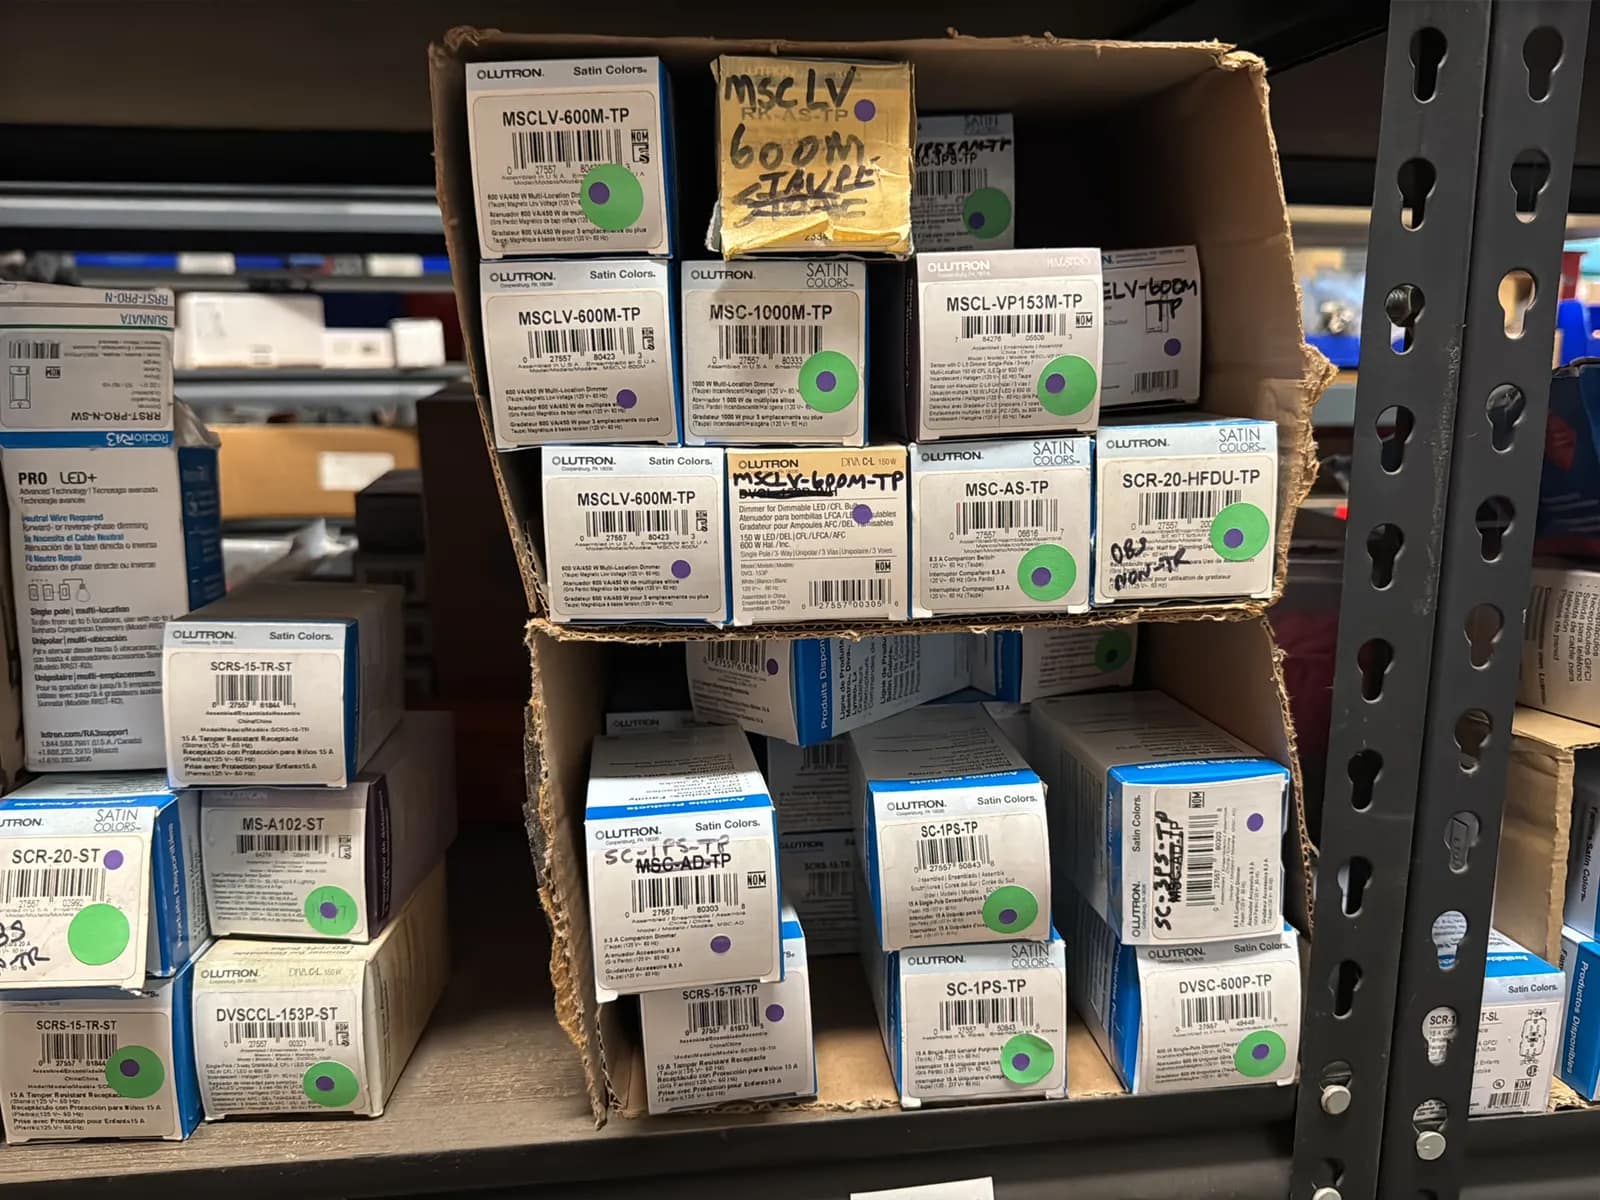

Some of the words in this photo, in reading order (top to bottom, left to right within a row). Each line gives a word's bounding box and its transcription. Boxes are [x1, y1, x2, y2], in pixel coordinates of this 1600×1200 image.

[573, 66, 602, 76] Satin
[503, 108, 629, 126] MSCLV-600M-TP
[632, 131, 648, 142] NOM
[590, 271, 616, 279] Satin
[807, 263, 848, 277] SATIN
[807, 278, 848, 288] COLORS
[105, 292, 168, 305] RRST-PRO-N
[947, 294, 1082, 312] MSCL-VP153M-TP
[519, 307, 641, 326] MSCLV-600M-TP
[710, 304, 832, 320] MSC-1000M-TP
[120, 313, 168, 325] SUNNATA
[1076, 315, 1092, 326] NOM
[550, 355, 571, 363] 27557
[594, 353, 615, 361] 80423
[71, 412, 161, 421] RRST-PRO-N-SW
[1219, 428, 1260, 442] SATIN
[1034, 441, 1074, 456] SATIN
[1219, 442, 1260, 452] COLORS
[649, 457, 674, 466] Satin
[1033, 455, 1074, 465] COLORS
[19, 472, 47, 485] PRO
[1123, 469, 1260, 488] SCR-20-HFDU-TP
[966, 481, 1049, 497] MSC-AS-TP
[578, 491, 695, 506] MSCLV-600M-TP
[791, 512, 822, 520] bombillas
[876, 561, 891, 571] NOM
[819, 602, 847, 610] 27557
[269, 632, 295, 640] Satin
[211, 662, 292, 671] SCRS-15-TR-ST
[820, 682, 828, 729] Produits
[977, 797, 1001, 806] Satin
[1192, 792, 1203, 808] NOM
[95, 809, 139, 822] SATIN
[94, 822, 136, 832] COLORS
[243, 818, 325, 831] MS-A102-ST
[696, 822, 721, 831] Satin
[921, 821, 978, 838] SC-1PS-TP
[1132, 826, 1141, 852] Satin
[12, 848, 100, 864] SCR-20-ST
[1584, 839, 1593, 867] Satin
[929, 864, 952, 872] 27557
[747, 873, 766, 886] NOM
[652, 908, 674, 916] 27557
[1012, 944, 1049, 958] SATIN
[1234, 944, 1257, 953] Satin
[947, 979, 1026, 997] SC-1PS-TP
[1179, 974, 1272, 994] DVSC-600P-TP
[1508, 985, 1528, 994] Satin
[1574, 961, 1588, 1016] Productos
[683, 984, 758, 1000] SCRS-15-TR-TP
[217, 1007, 338, 1022] DVSCCL-153P-ST
[37, 1020, 117, 1031] SCRS-15-TR-ST
[1567, 1015, 1581, 1074] Disponibles
